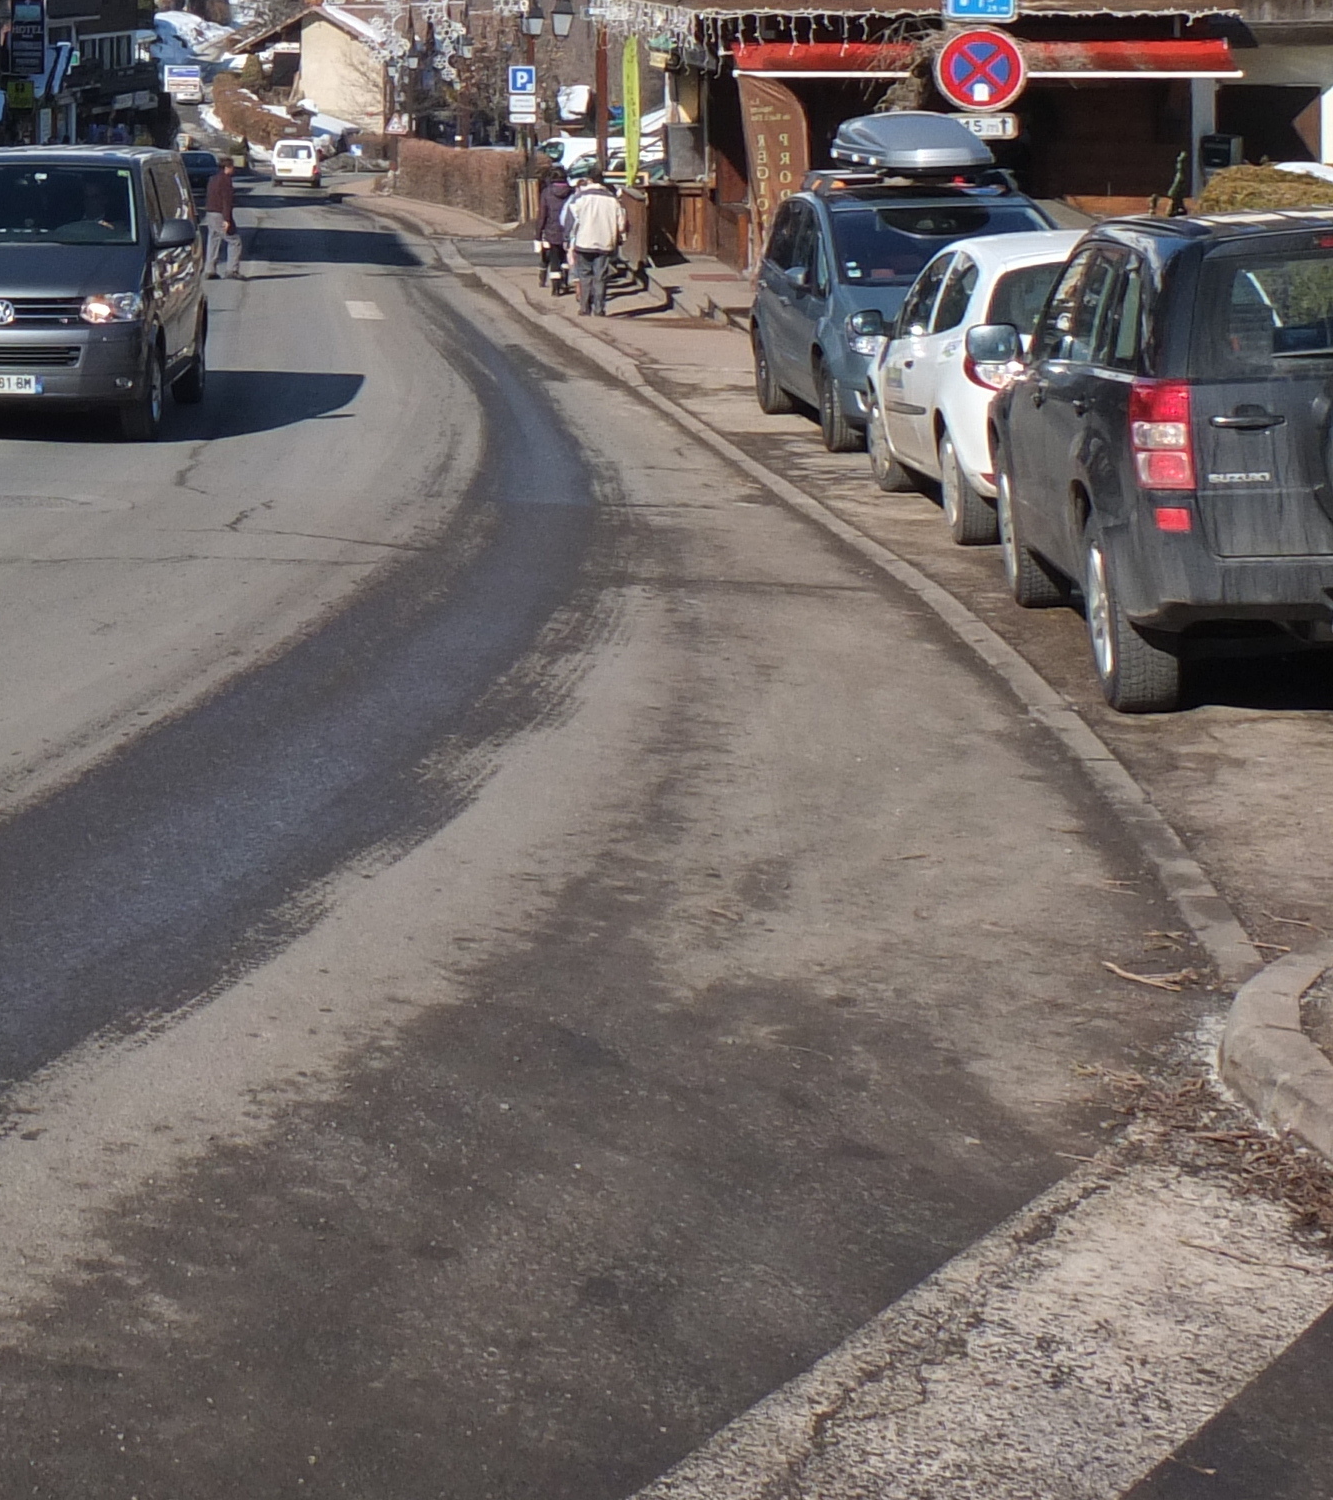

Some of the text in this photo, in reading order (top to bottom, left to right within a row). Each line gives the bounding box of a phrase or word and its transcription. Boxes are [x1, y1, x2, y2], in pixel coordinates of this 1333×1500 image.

[12, 25, 43, 34] HOTEL
[516, 71, 529, 88] P
[1208, 472, 1272, 483] SUZUKI
